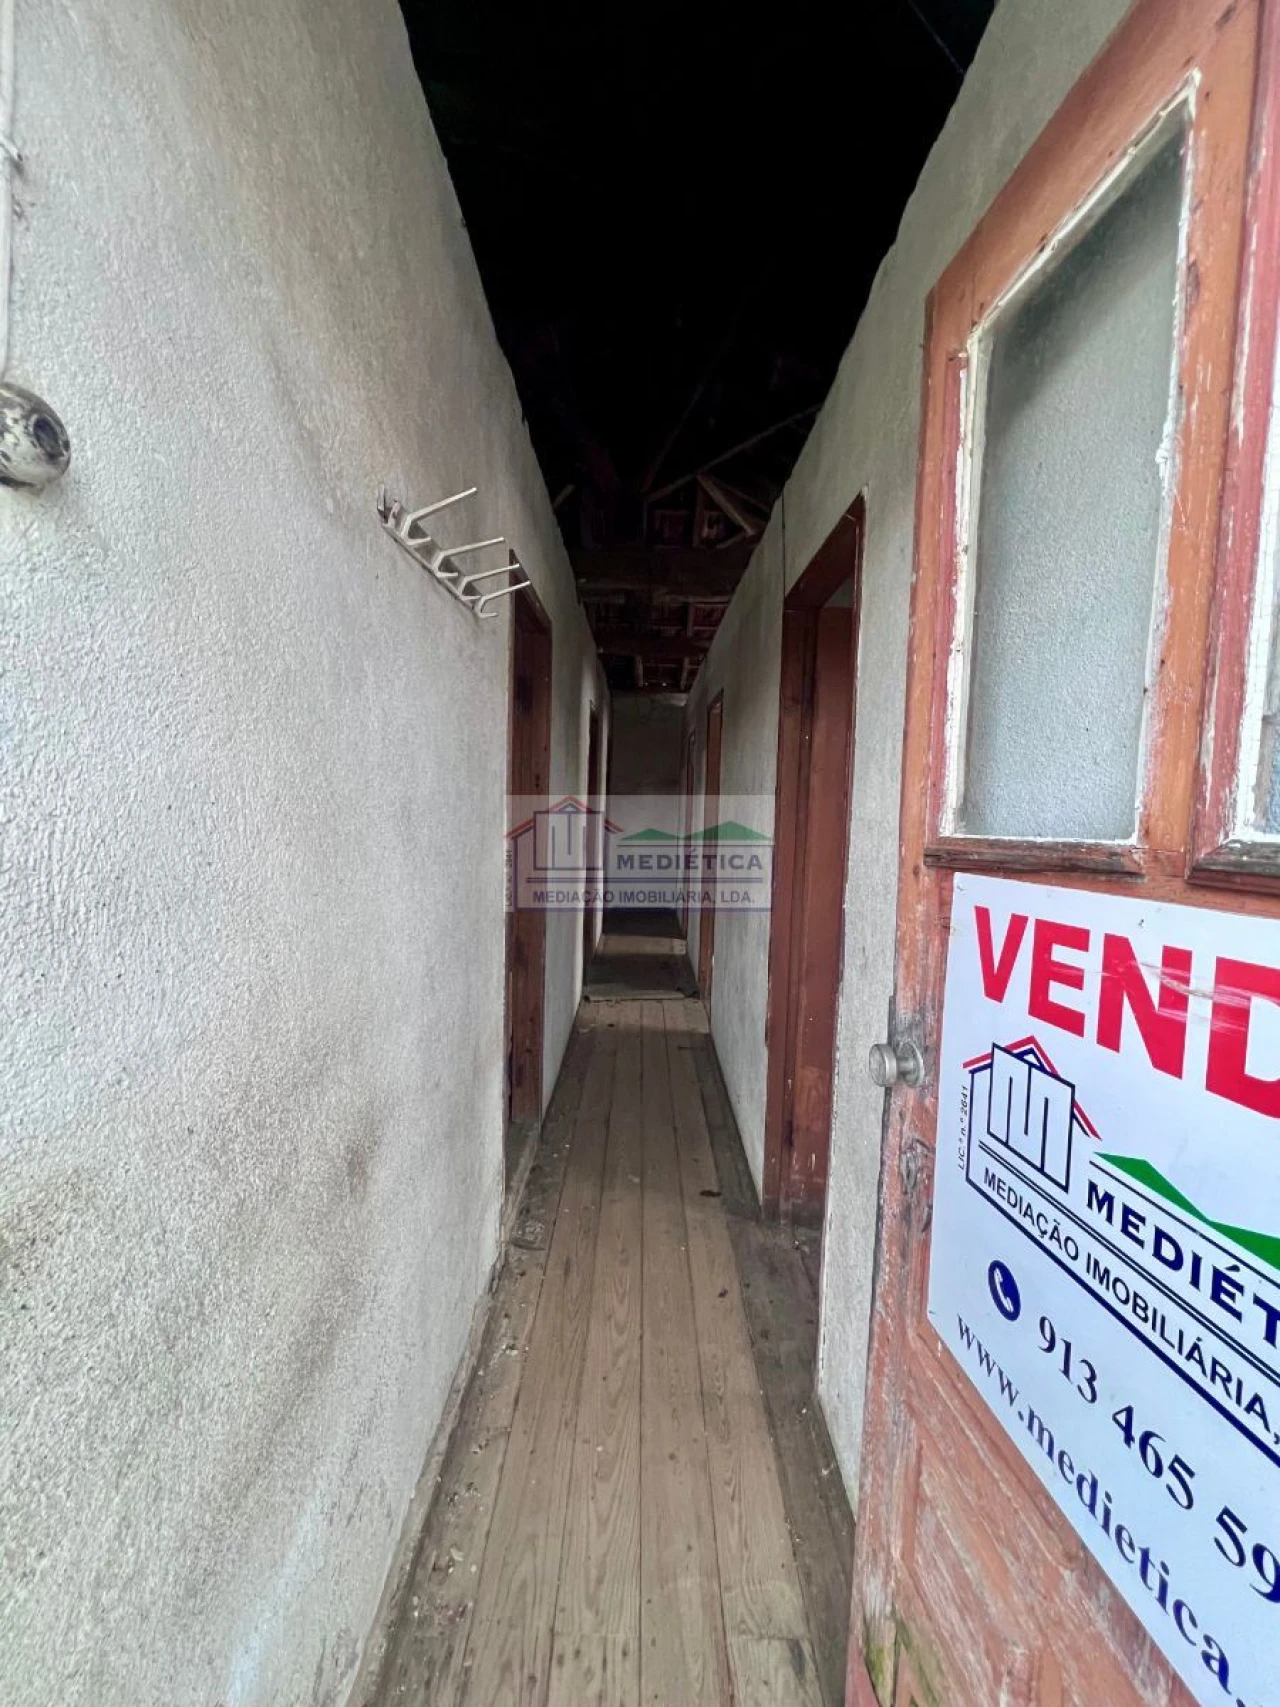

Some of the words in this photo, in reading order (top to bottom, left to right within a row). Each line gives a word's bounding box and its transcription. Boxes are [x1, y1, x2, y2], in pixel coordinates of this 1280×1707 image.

[974, 905, 1280, 1120] VEND
[983, 1167, 1079, 1261] MEDIAÇÃO
[1038, 1316, 1098, 1404] 913
[1112, 1404, 1196, 1510] 465
